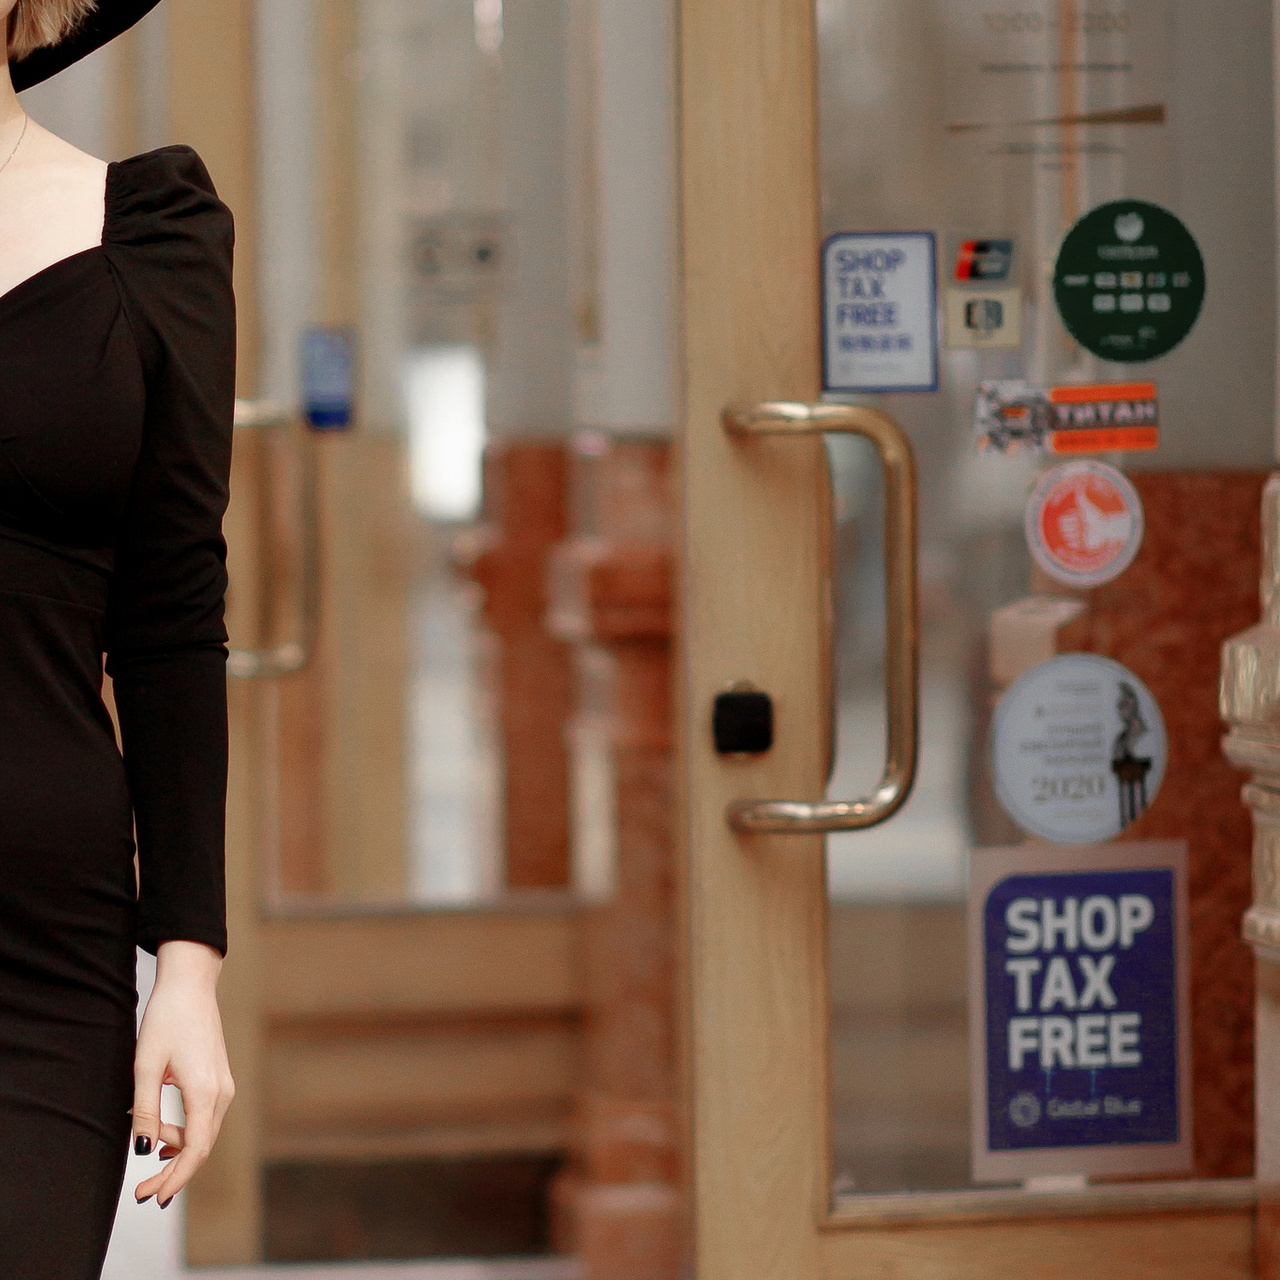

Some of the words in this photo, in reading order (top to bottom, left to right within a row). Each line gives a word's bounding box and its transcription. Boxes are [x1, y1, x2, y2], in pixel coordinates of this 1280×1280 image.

[836, 248, 906, 273] SHOP
[836, 273, 885, 298] TAX
[836, 301, 898, 329] FREE
[1055, 401, 1156, 424] ТИТАН
[1031, 774, 1107, 803] 2020
[1005, 894, 1156, 954] SHOP
[1005, 954, 1118, 1012] TAX
[1007, 1011, 1143, 1072] FREE
